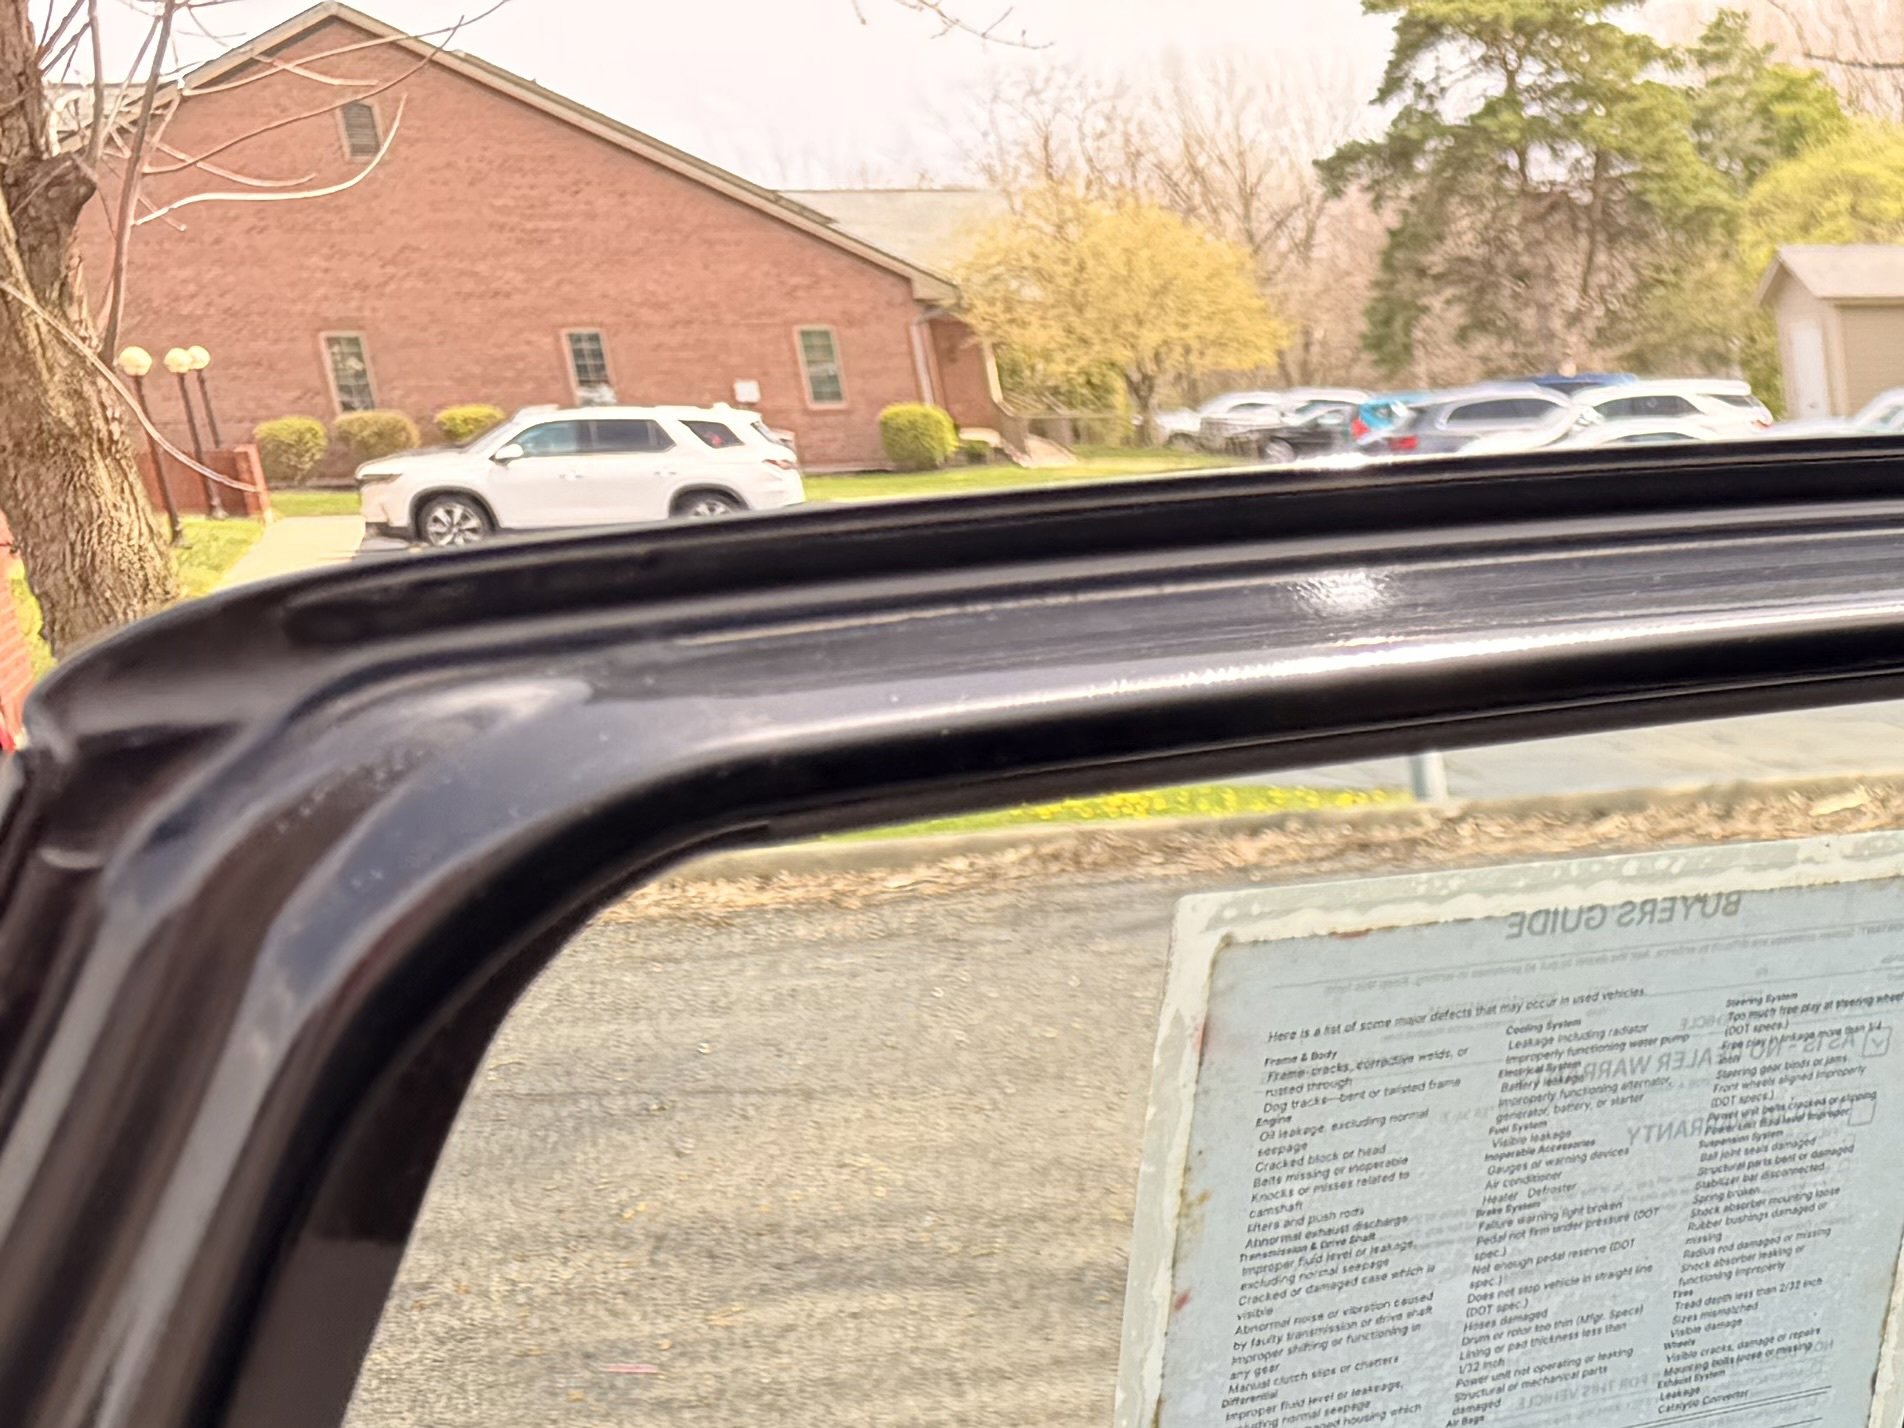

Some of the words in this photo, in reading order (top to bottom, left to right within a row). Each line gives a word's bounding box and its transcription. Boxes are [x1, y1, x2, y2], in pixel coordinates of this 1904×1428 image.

[1254, 1155, 1305, 1173] Cracked
[1307, 1151, 1339, 1165] block
[1341, 1149, 1354, 1160] or
[1357, 1143, 1387, 1158] head
